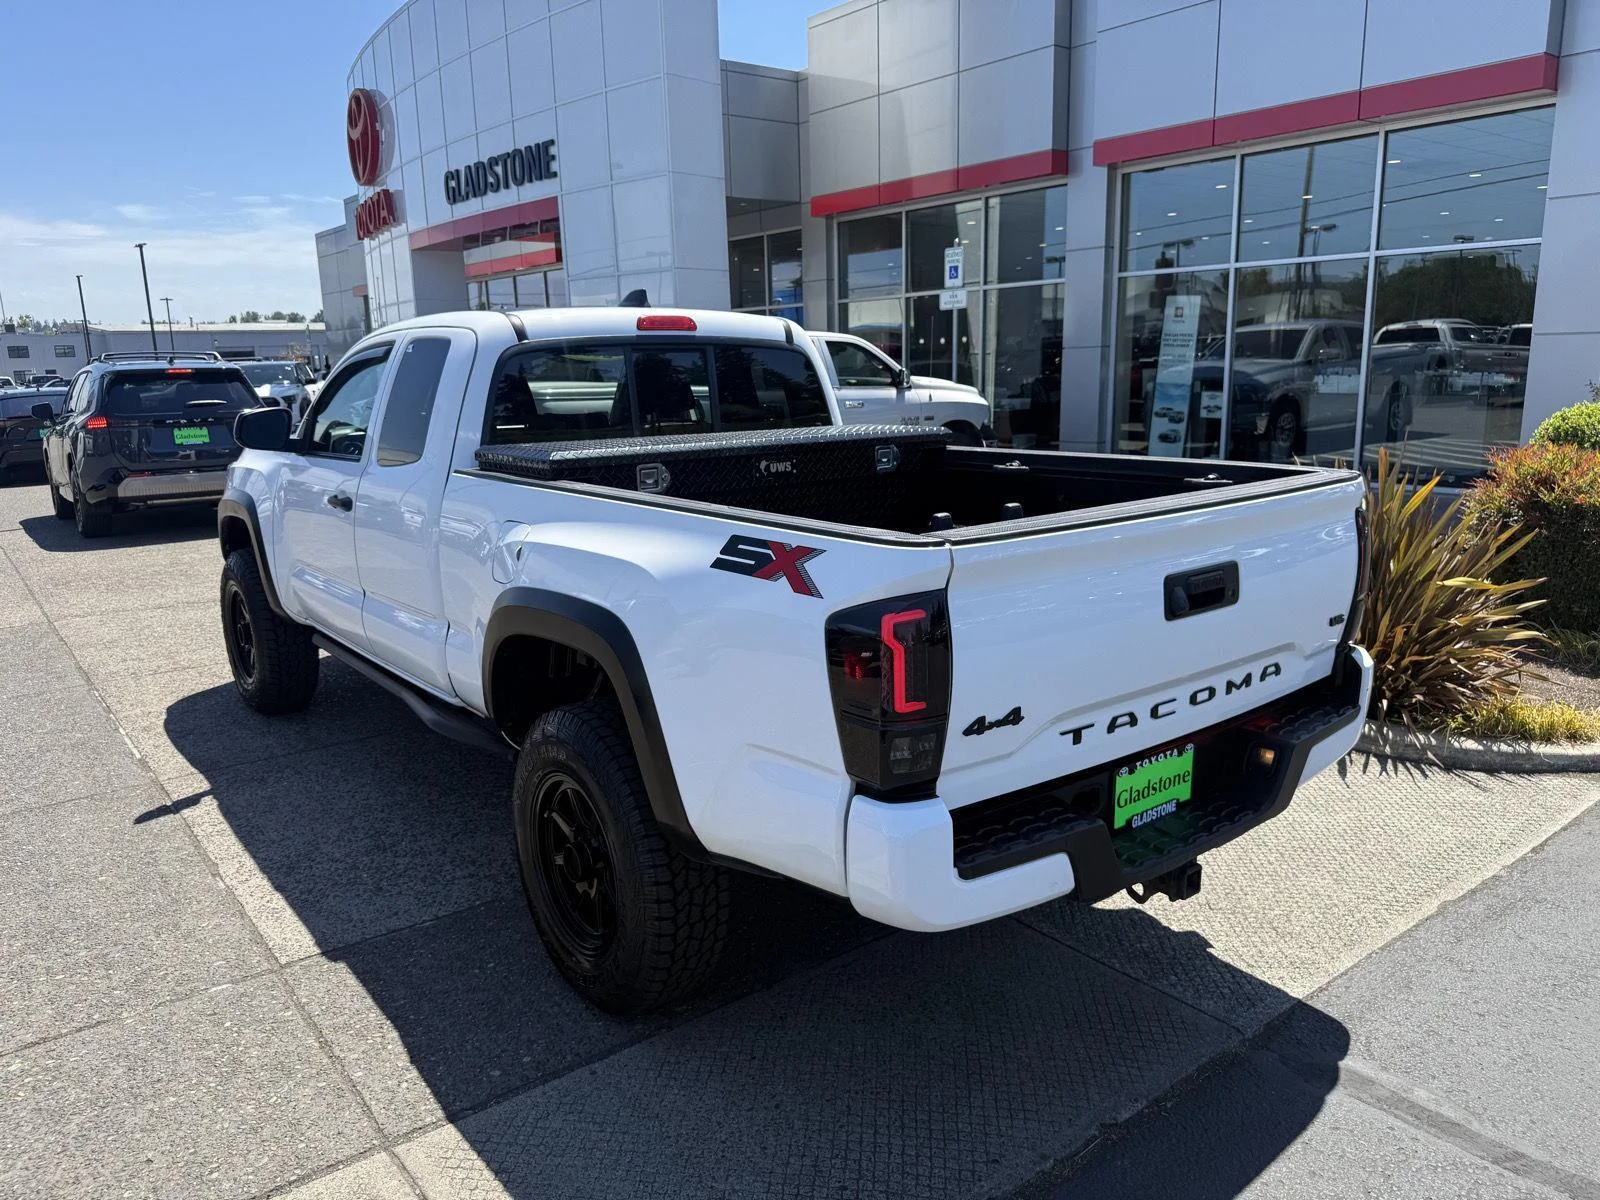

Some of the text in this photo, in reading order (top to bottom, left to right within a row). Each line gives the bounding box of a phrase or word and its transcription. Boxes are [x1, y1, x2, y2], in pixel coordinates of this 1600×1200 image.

[444, 139, 558, 206] GLADSTONE
[355, 189, 394, 240] TOYOTA
[770, 461, 791, 473] UWS
[709, 534, 828, 599] SX
[962, 705, 1025, 736] 4x4
[1059, 661, 1282, 746] TACOMA
[1135, 748, 1178, 770] TOYOTA
[1116, 769, 1191, 809] Gladstone
[1131, 799, 1177, 829] GLADSTONE
